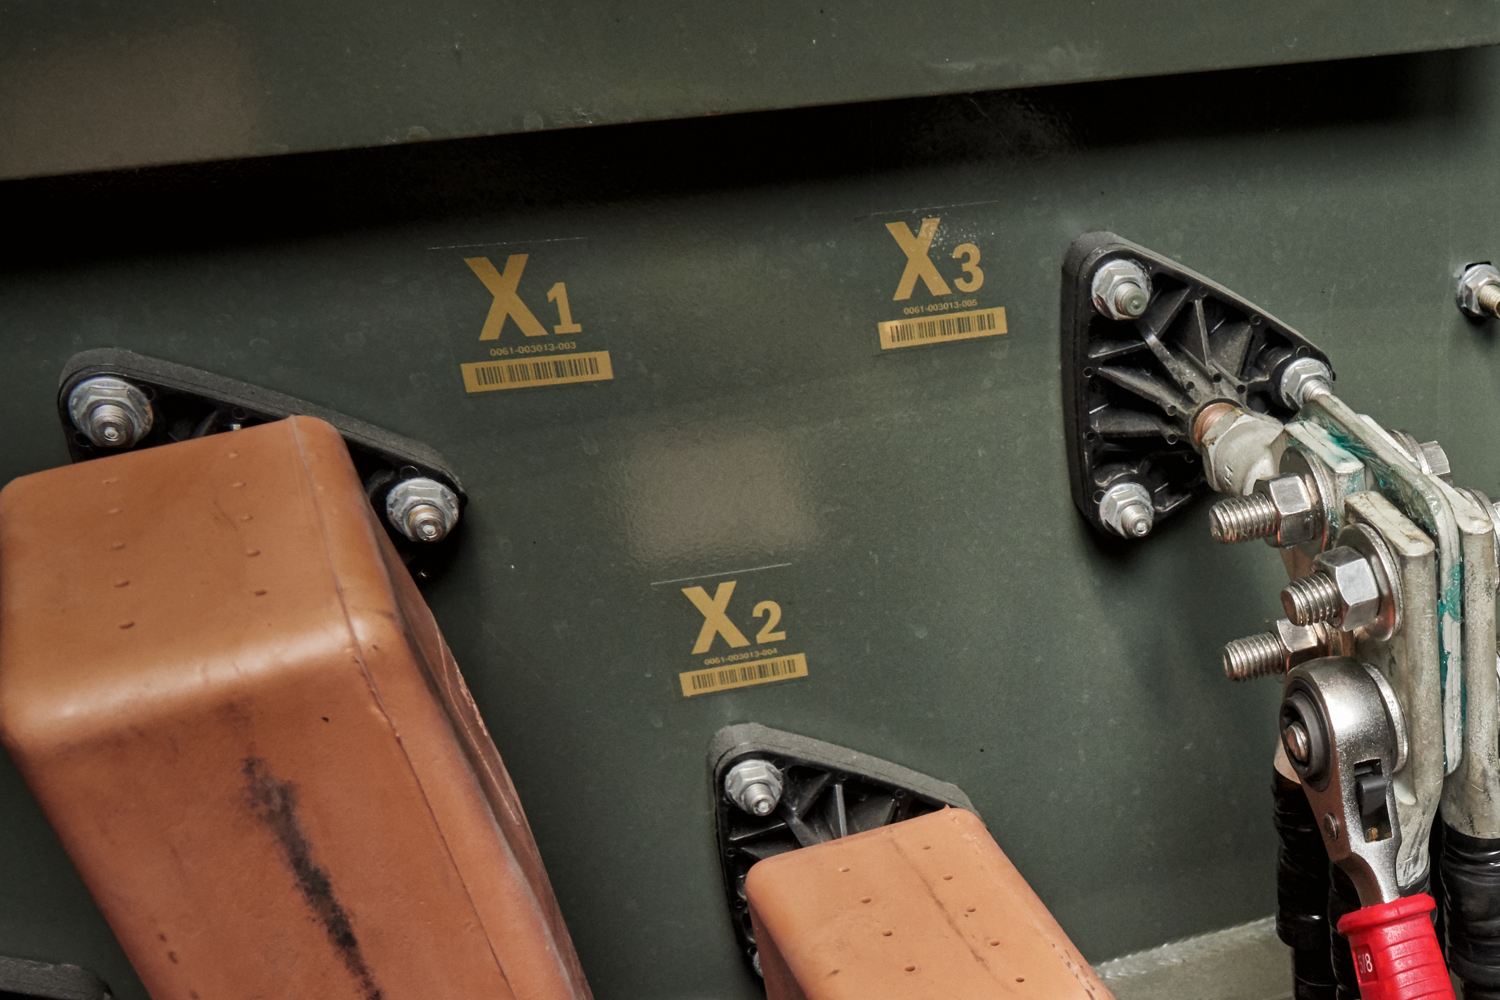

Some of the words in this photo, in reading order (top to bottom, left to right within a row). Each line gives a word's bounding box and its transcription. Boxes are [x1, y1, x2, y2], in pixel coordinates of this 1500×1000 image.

[885, 217, 984, 301] X3
[463, 253, 582, 341] X1
[904, 299, 978, 315] 0061-003013-005
[490, 341, 577, 357] 0061-003013-003
[681, 580, 786, 655] X2
